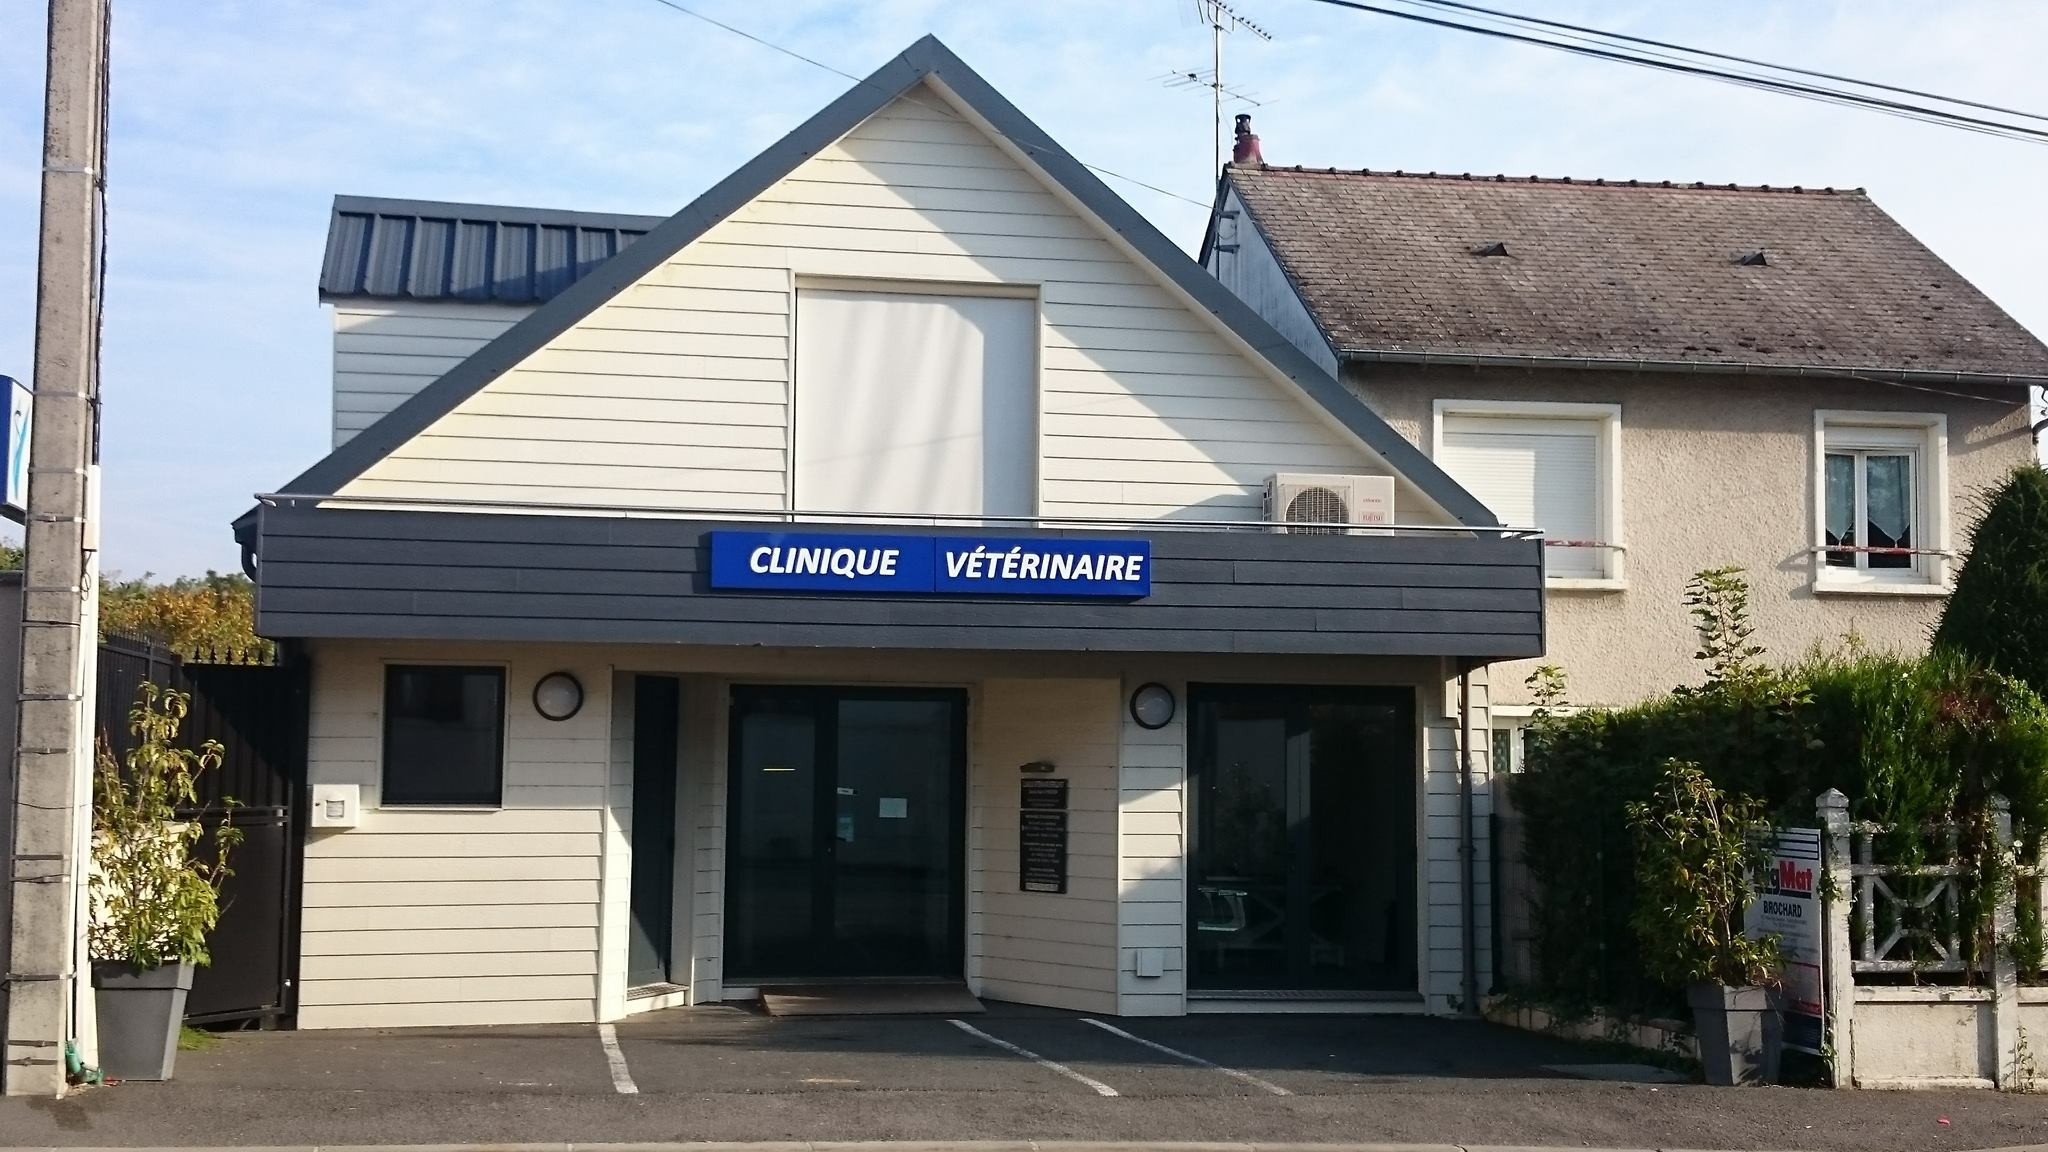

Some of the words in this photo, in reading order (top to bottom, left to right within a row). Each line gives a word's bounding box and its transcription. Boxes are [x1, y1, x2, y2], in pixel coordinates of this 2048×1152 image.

[750, 546, 900, 579] CLINIQUE
[946, 545, 1144, 581] VÉTÉRINAIRE
[1763, 900, 1802, 918] BROCHARD
